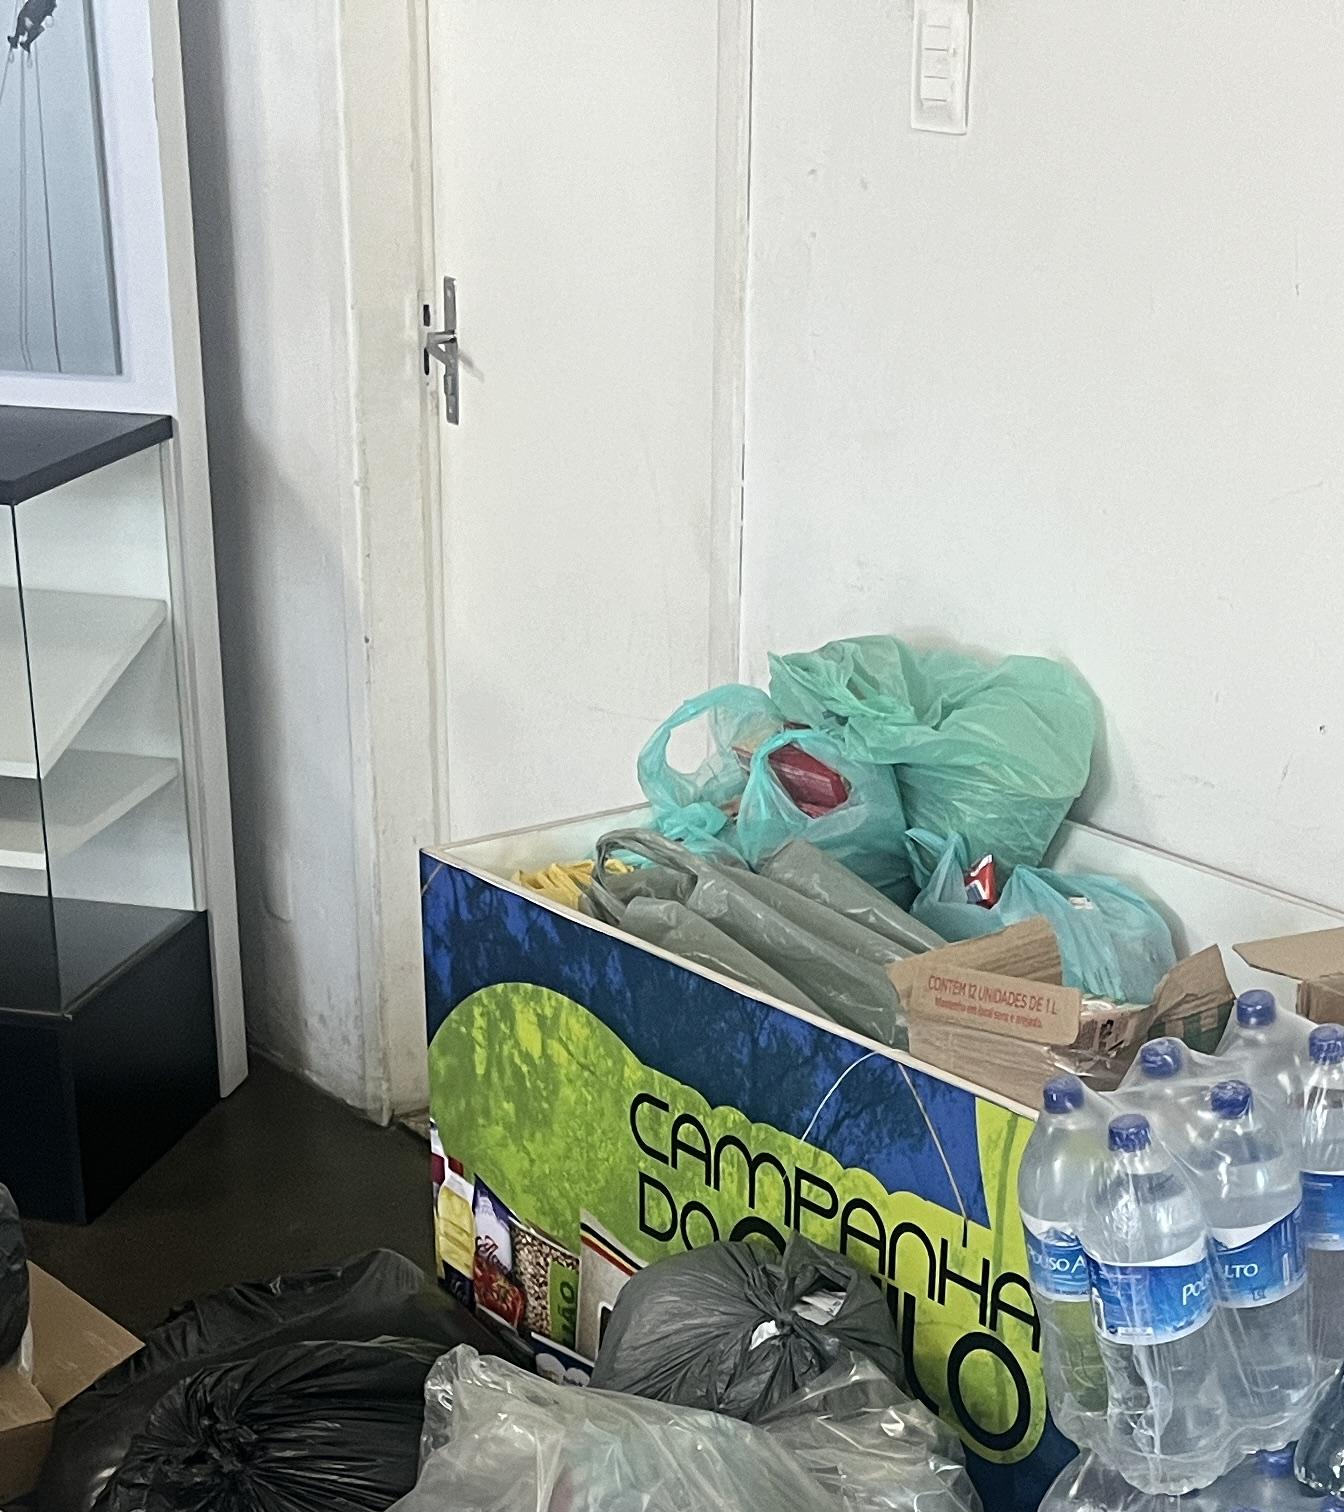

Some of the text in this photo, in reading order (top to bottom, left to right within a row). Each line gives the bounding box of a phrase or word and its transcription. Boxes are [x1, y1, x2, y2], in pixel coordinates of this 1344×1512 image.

[978, 985, 1028, 1009] UNIDADES
[1028, 995, 1042, 1013] DE
[629, 1092, 1041, 1353] CAMPANHA
[639, 1170, 721, 1252] DO
[1222, 1263, 1259, 1279] LTO
